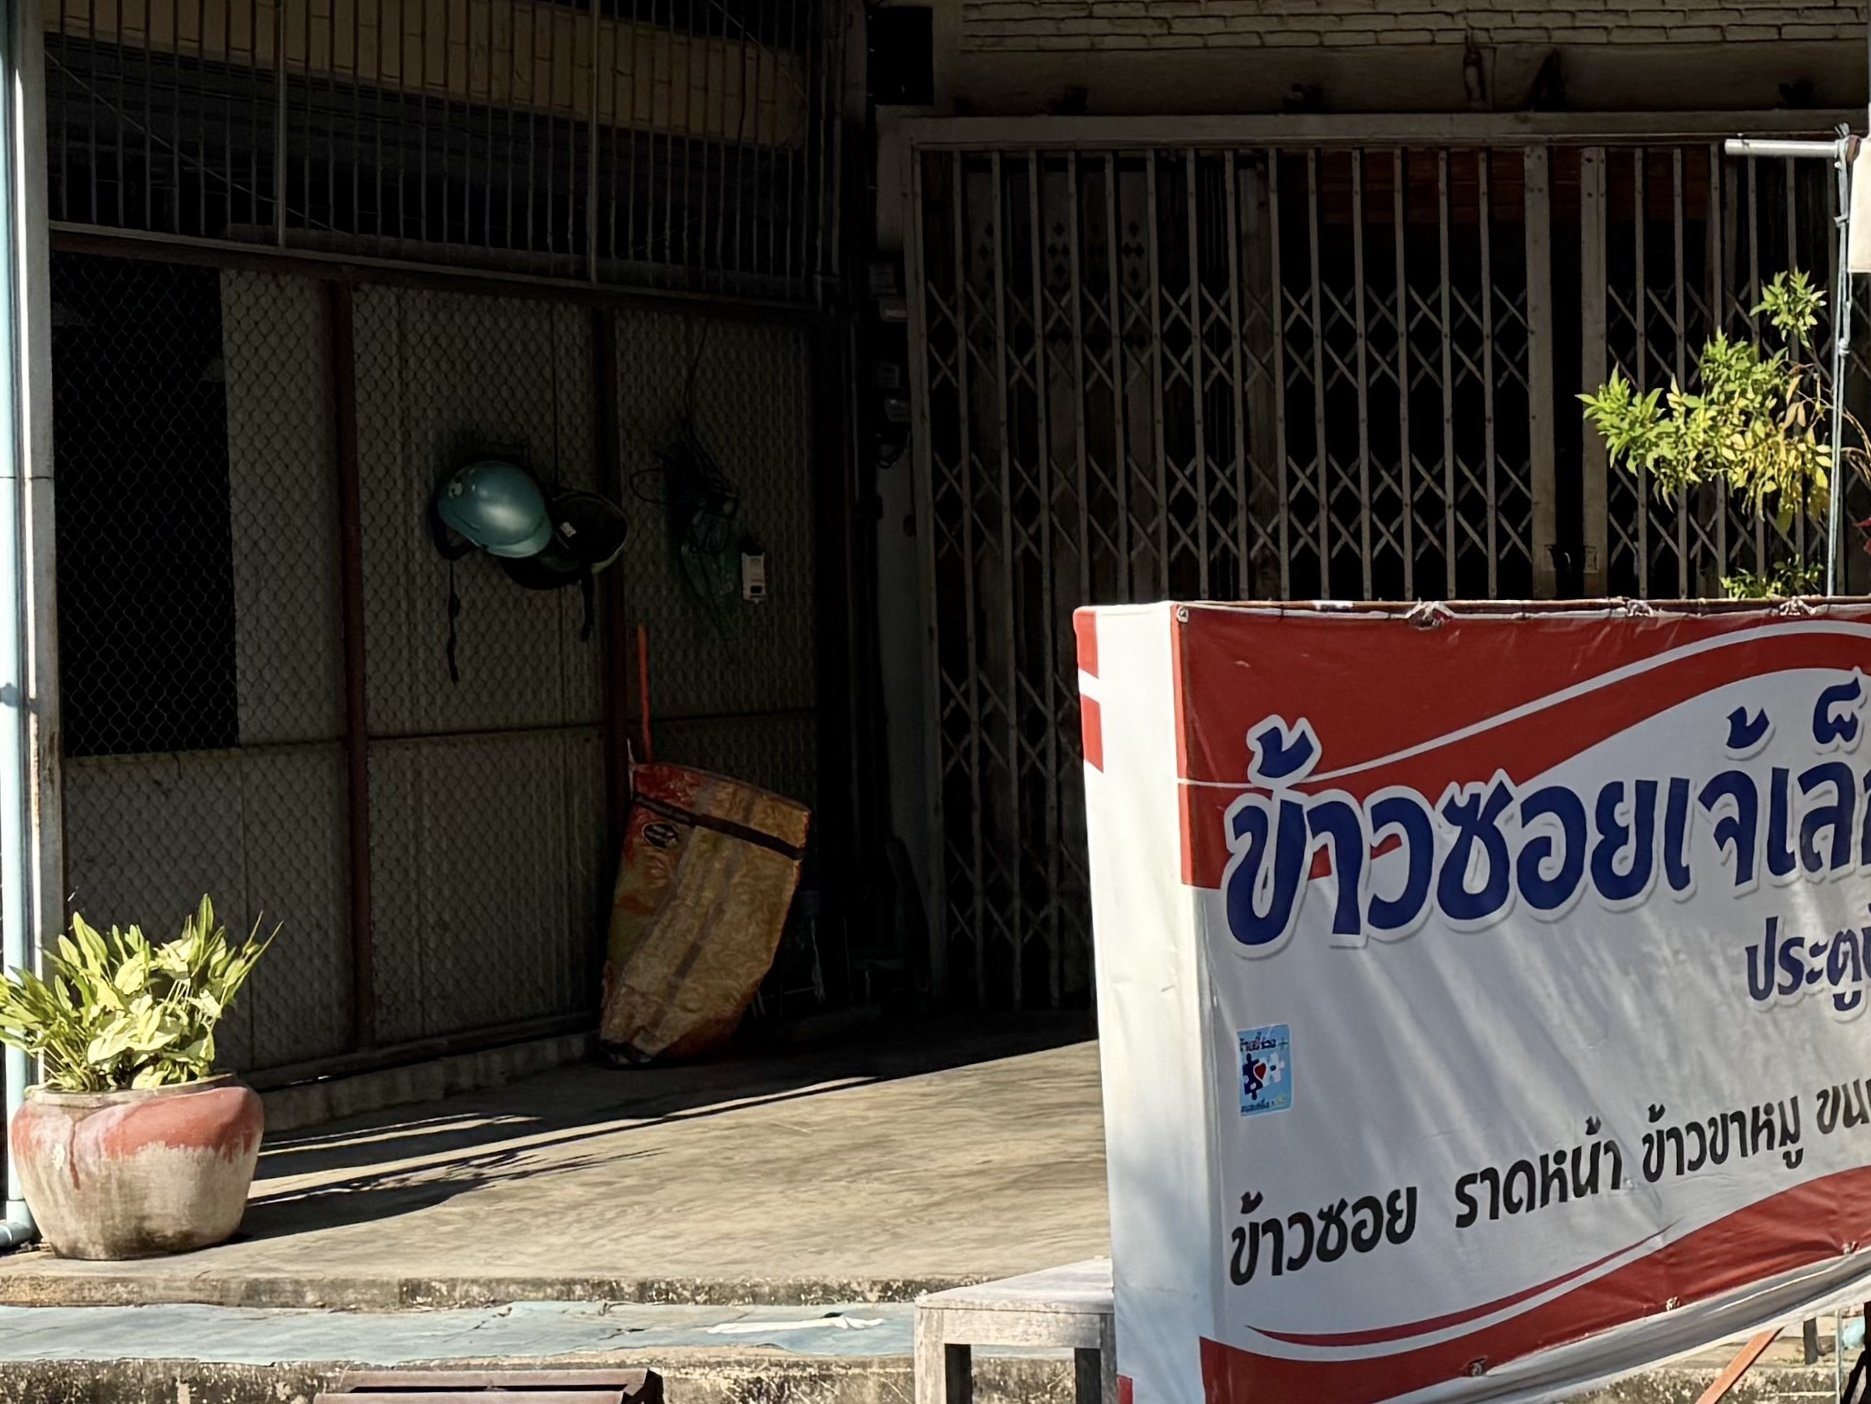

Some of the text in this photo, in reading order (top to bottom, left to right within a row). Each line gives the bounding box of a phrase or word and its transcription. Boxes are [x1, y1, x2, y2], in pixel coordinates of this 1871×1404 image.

[1230, 1186, 1417, 1286] ข้าวซอย
[1454, 1115, 1623, 1229] ราดหน้า
[1642, 1095, 1804, 1183] ข้าวขาหมู
